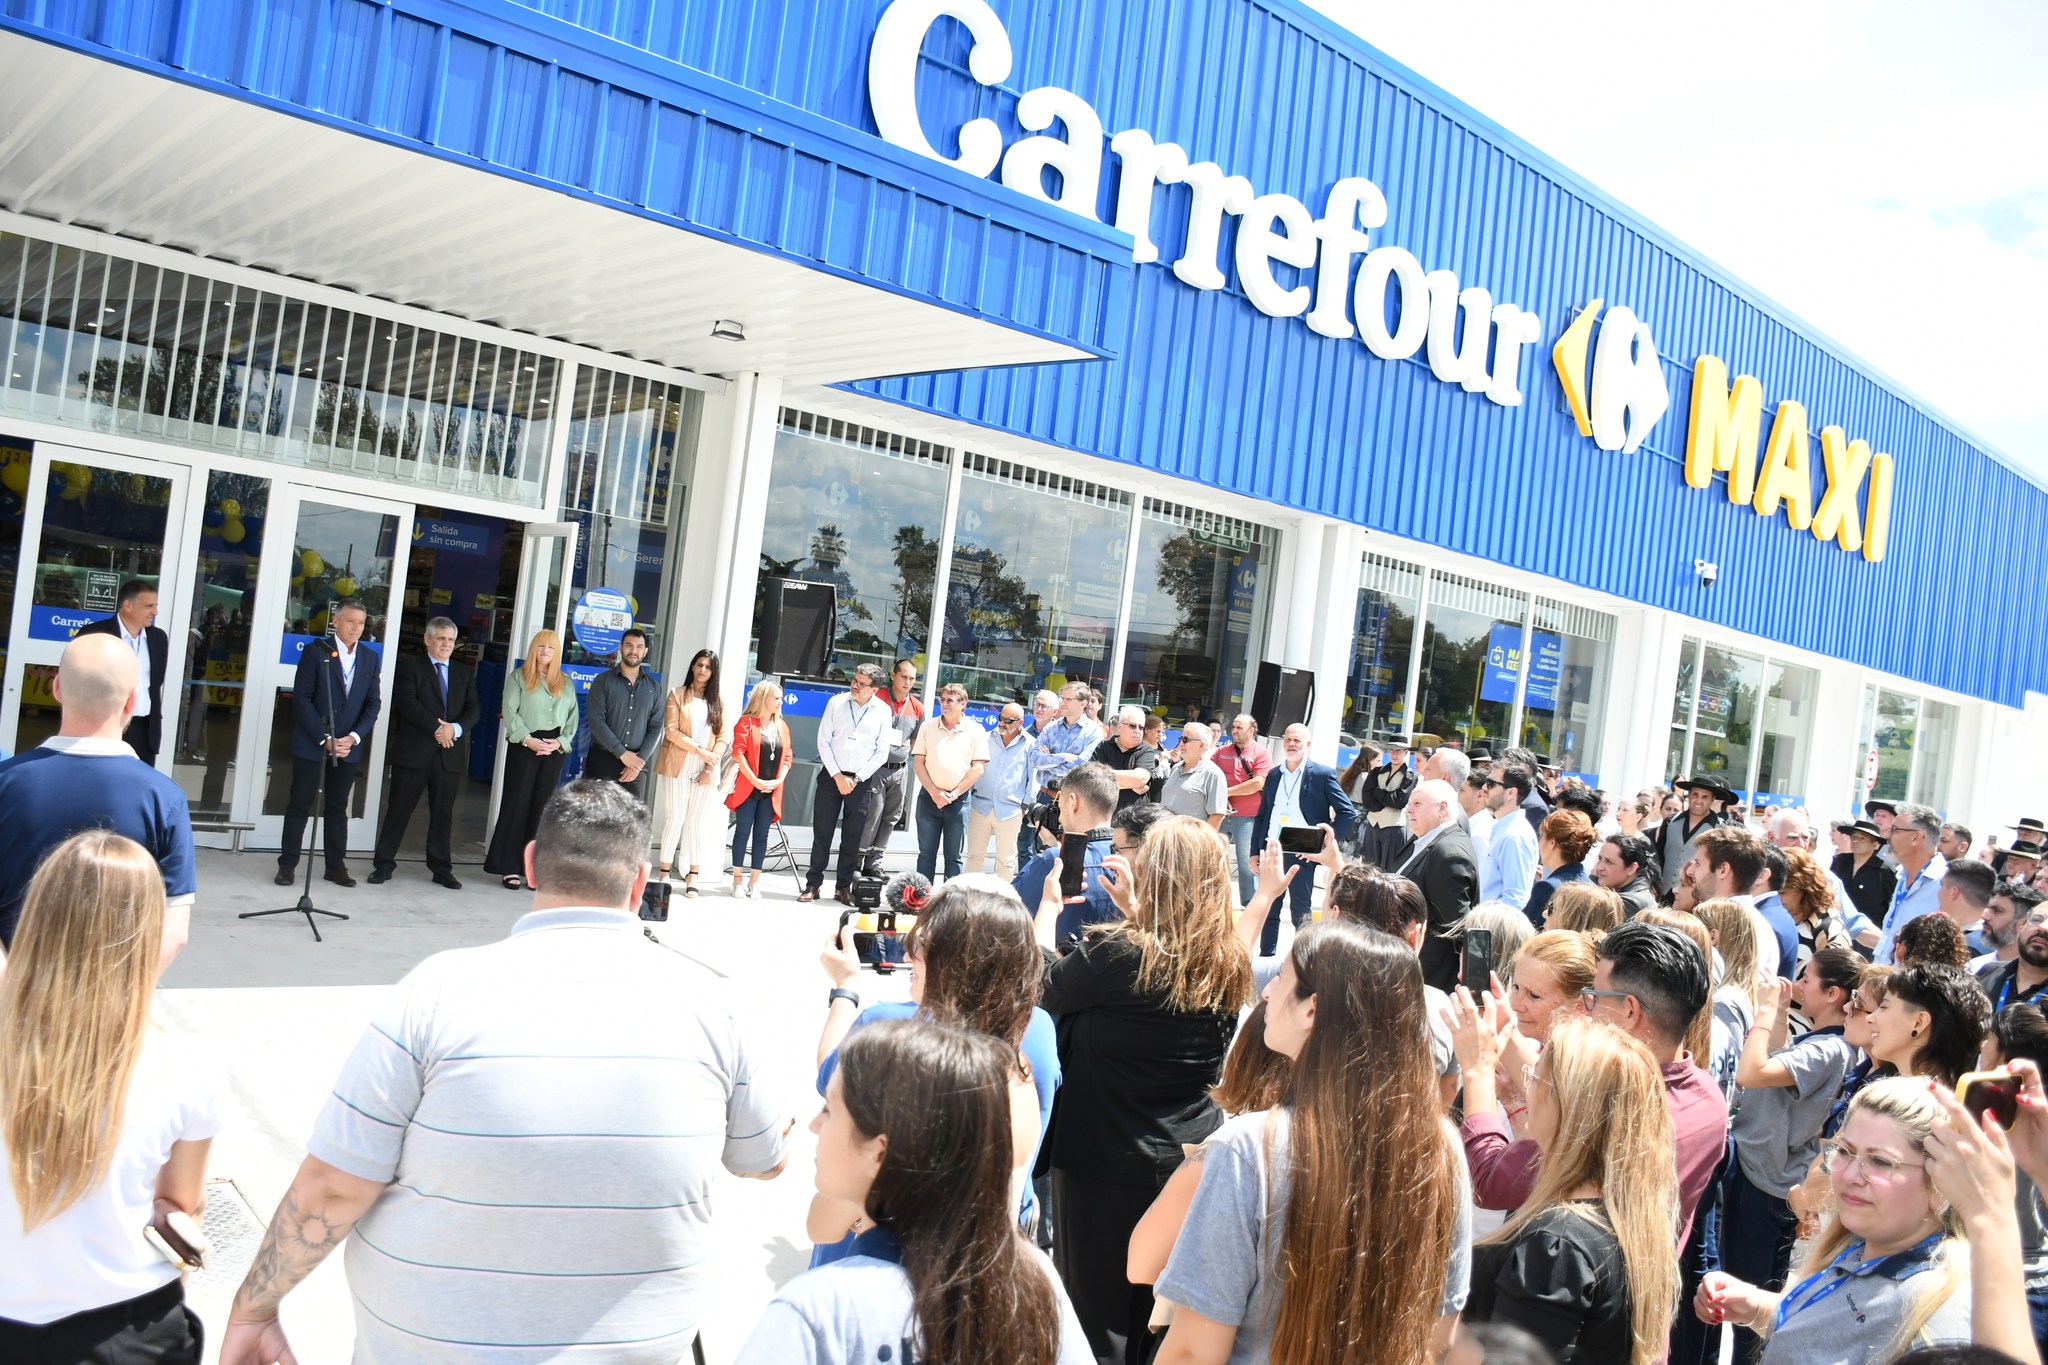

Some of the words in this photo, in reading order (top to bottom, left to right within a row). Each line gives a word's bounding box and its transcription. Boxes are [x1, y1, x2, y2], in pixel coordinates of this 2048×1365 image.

[868, 0, 1540, 406] Carrefour
[1685, 355, 1893, 562] MAXI
[431, 524, 459, 536] Salida
[429, 536, 443, 544] sin
[445, 538, 478, 549] compra
[956, 534, 983, 546] arrefour
